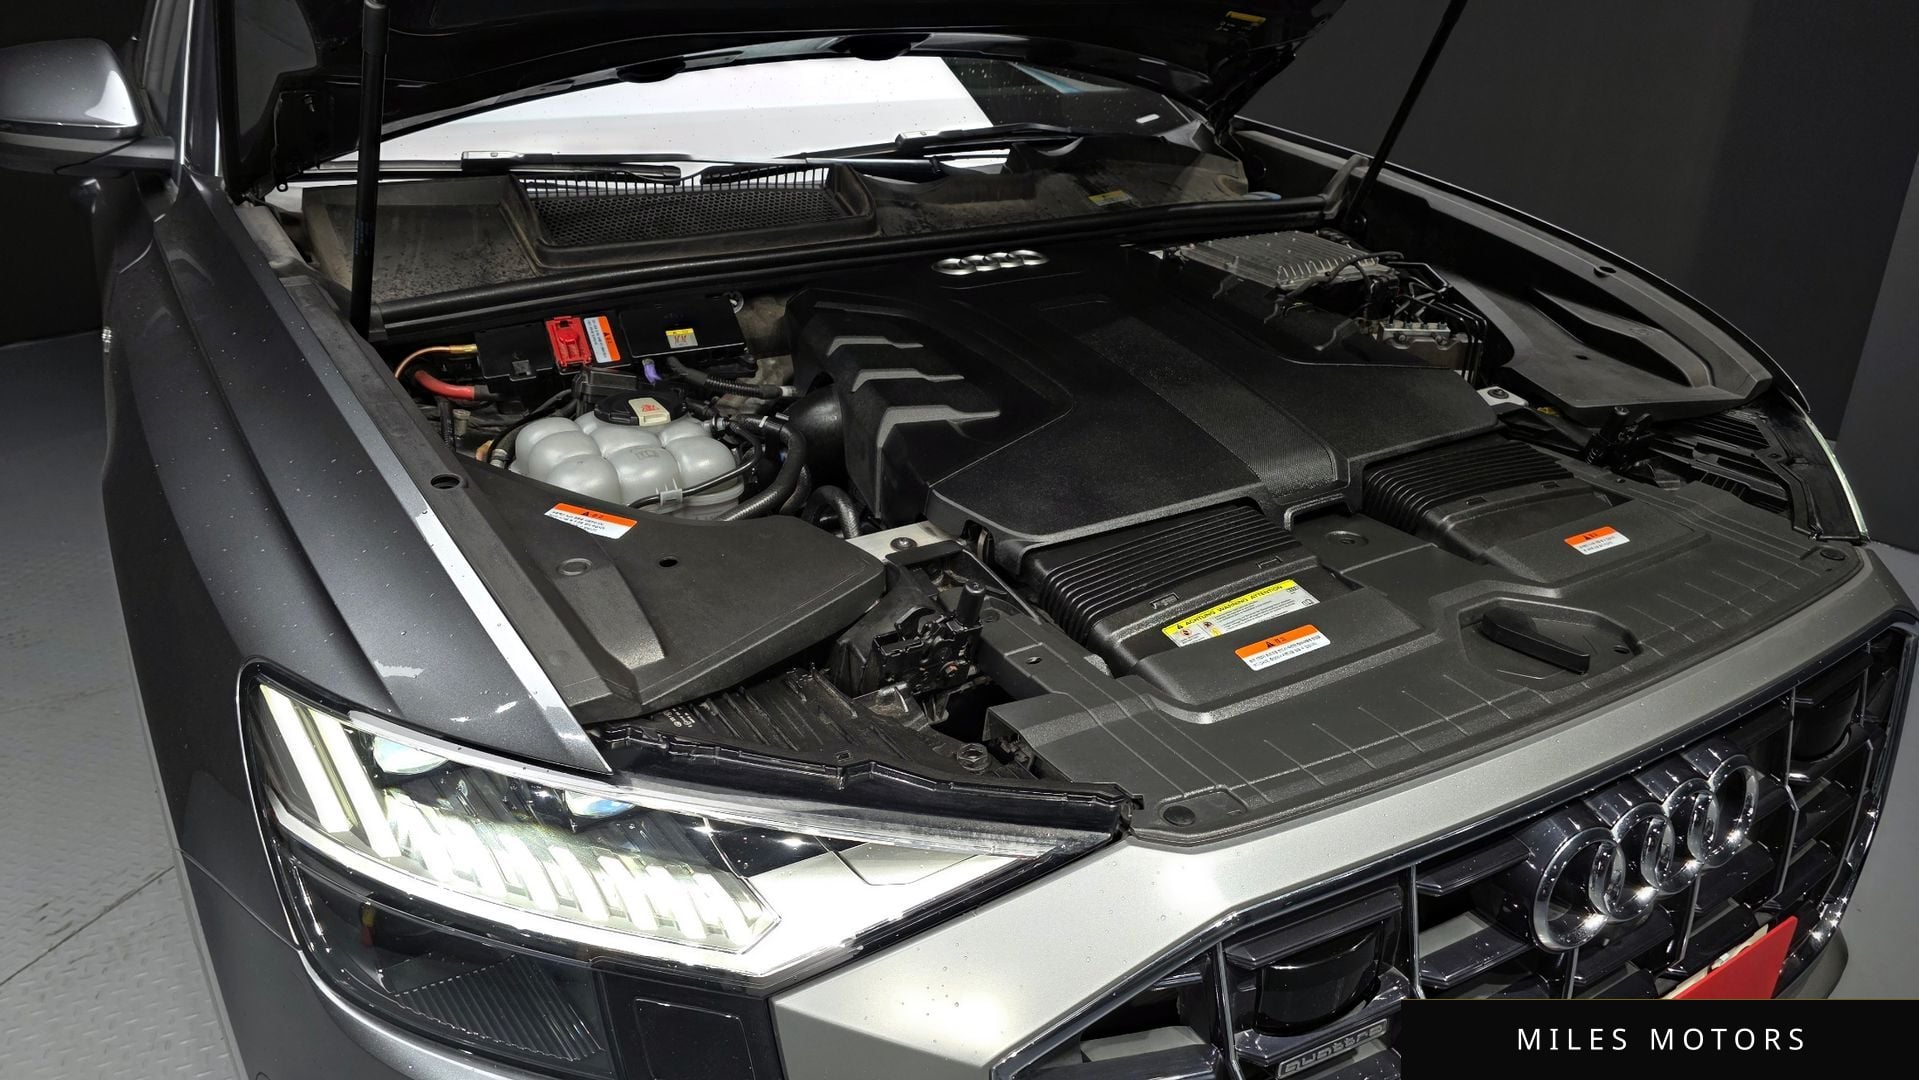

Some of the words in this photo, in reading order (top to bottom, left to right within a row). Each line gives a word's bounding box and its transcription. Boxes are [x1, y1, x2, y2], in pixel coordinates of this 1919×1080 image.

[1185, 611, 1216, 626] ACHTUNG
[1218, 598, 1249, 613] WARNING
[1250, 585, 1283, 600] ATTENTION
[1285, 1024, 1383, 1073] quattro
